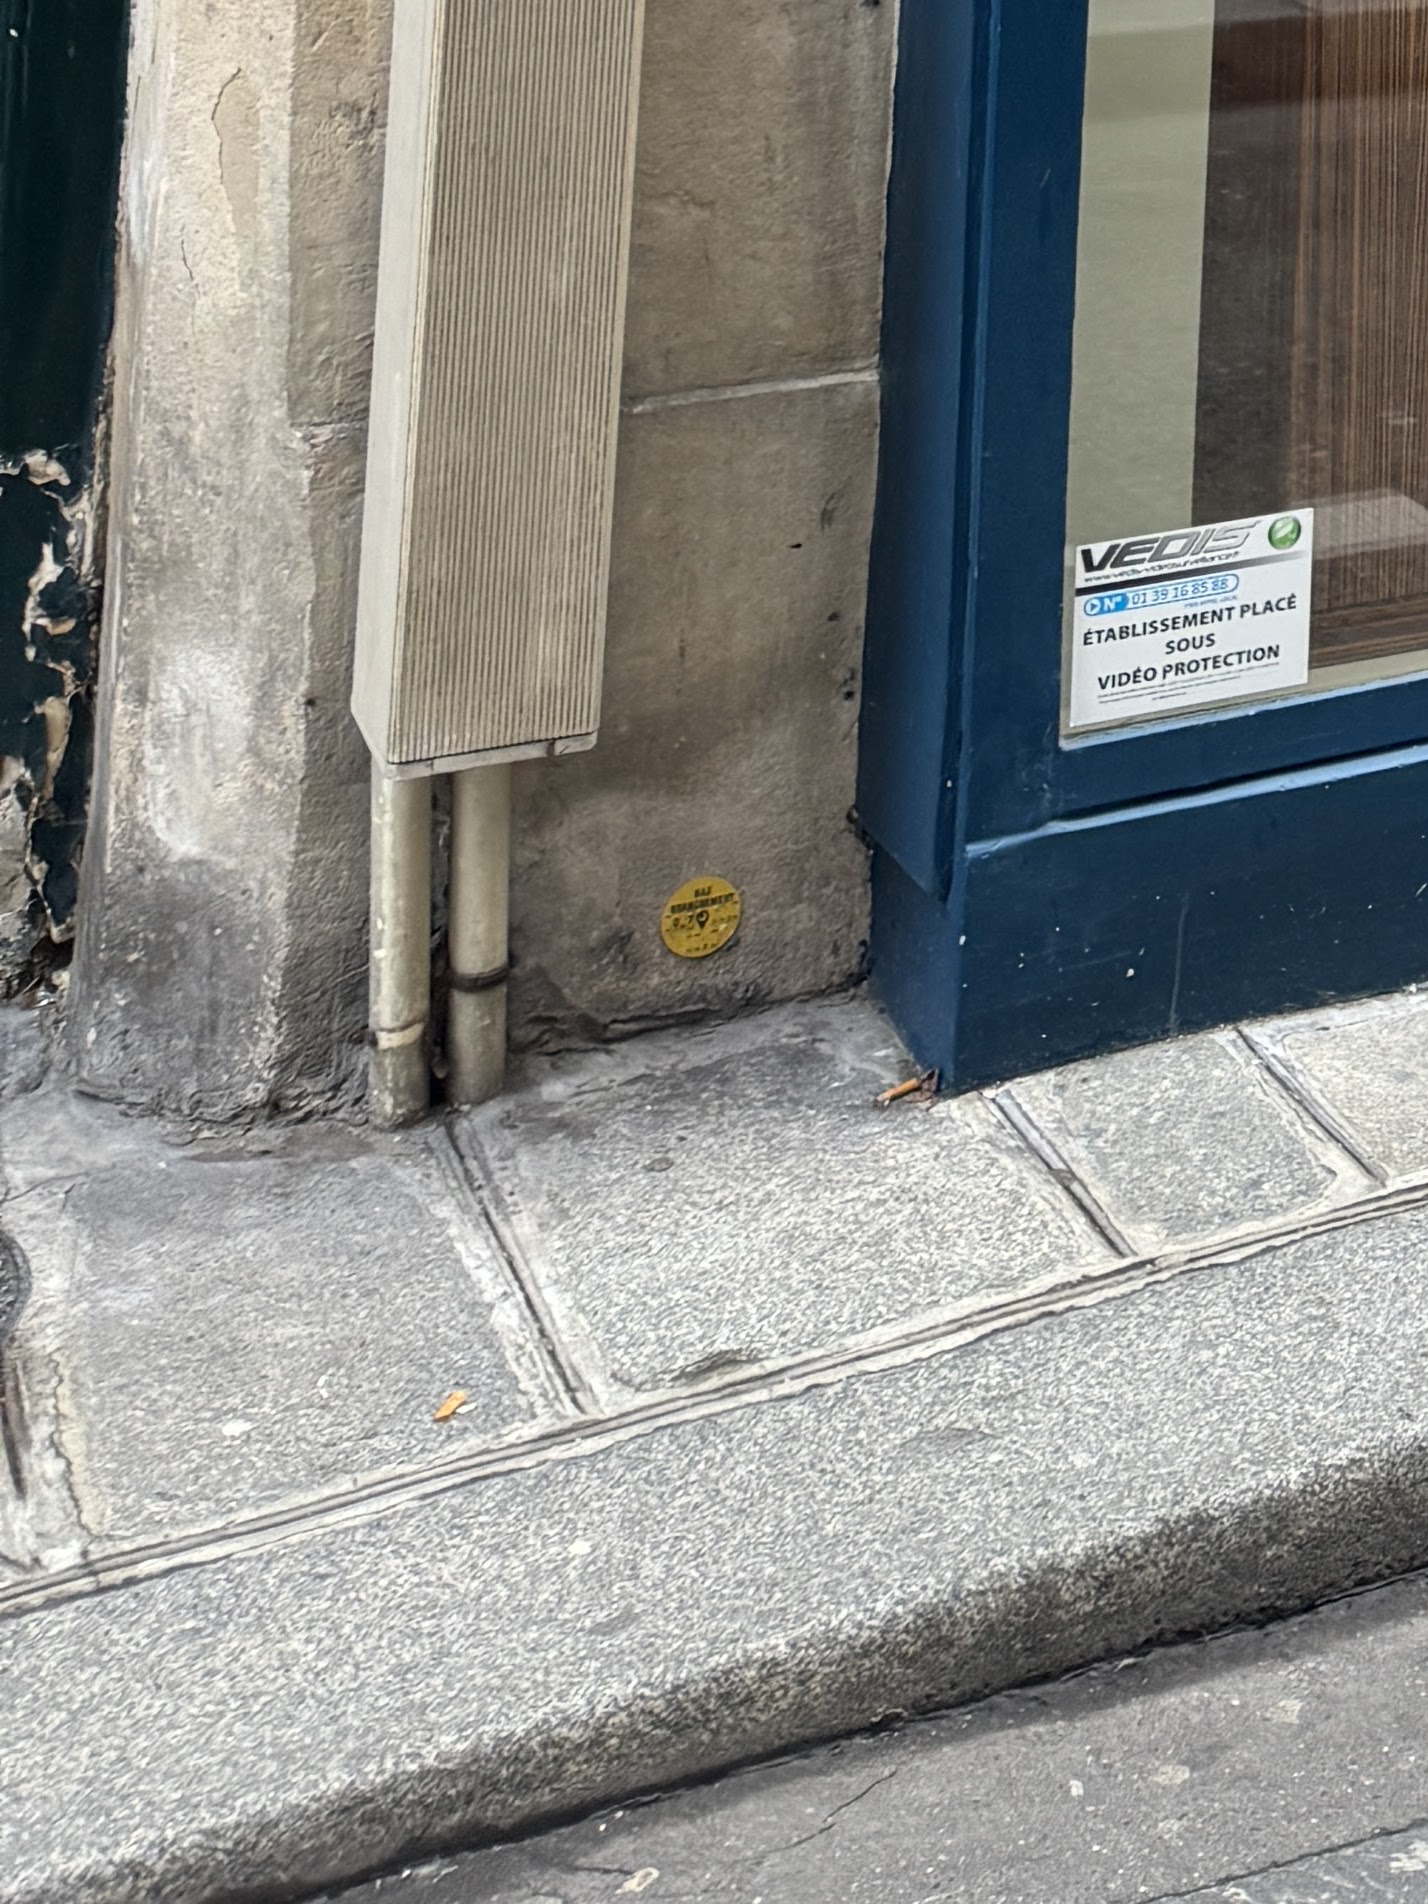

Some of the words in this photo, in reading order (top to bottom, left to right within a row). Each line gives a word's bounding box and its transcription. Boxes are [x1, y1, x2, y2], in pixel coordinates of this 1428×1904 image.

[1081, 520, 1262, 574] VEDIS
[1082, 607, 1236, 646] ÉTABLISSEMENT
[1239, 593, 1298, 619] PLACÉ
[1102, 596, 1122, 613] N°
[1132, 592, 1147, 605] 01
[1153, 589, 1170, 602] 39
[1172, 585, 1189, 598] 16
[1191, 581, 1209, 595] 85
[1165, 632, 1217, 655] SOUS
[1097, 665, 1157, 690] VIDÉO
[1161, 644, 1281, 681] PROTECTION
